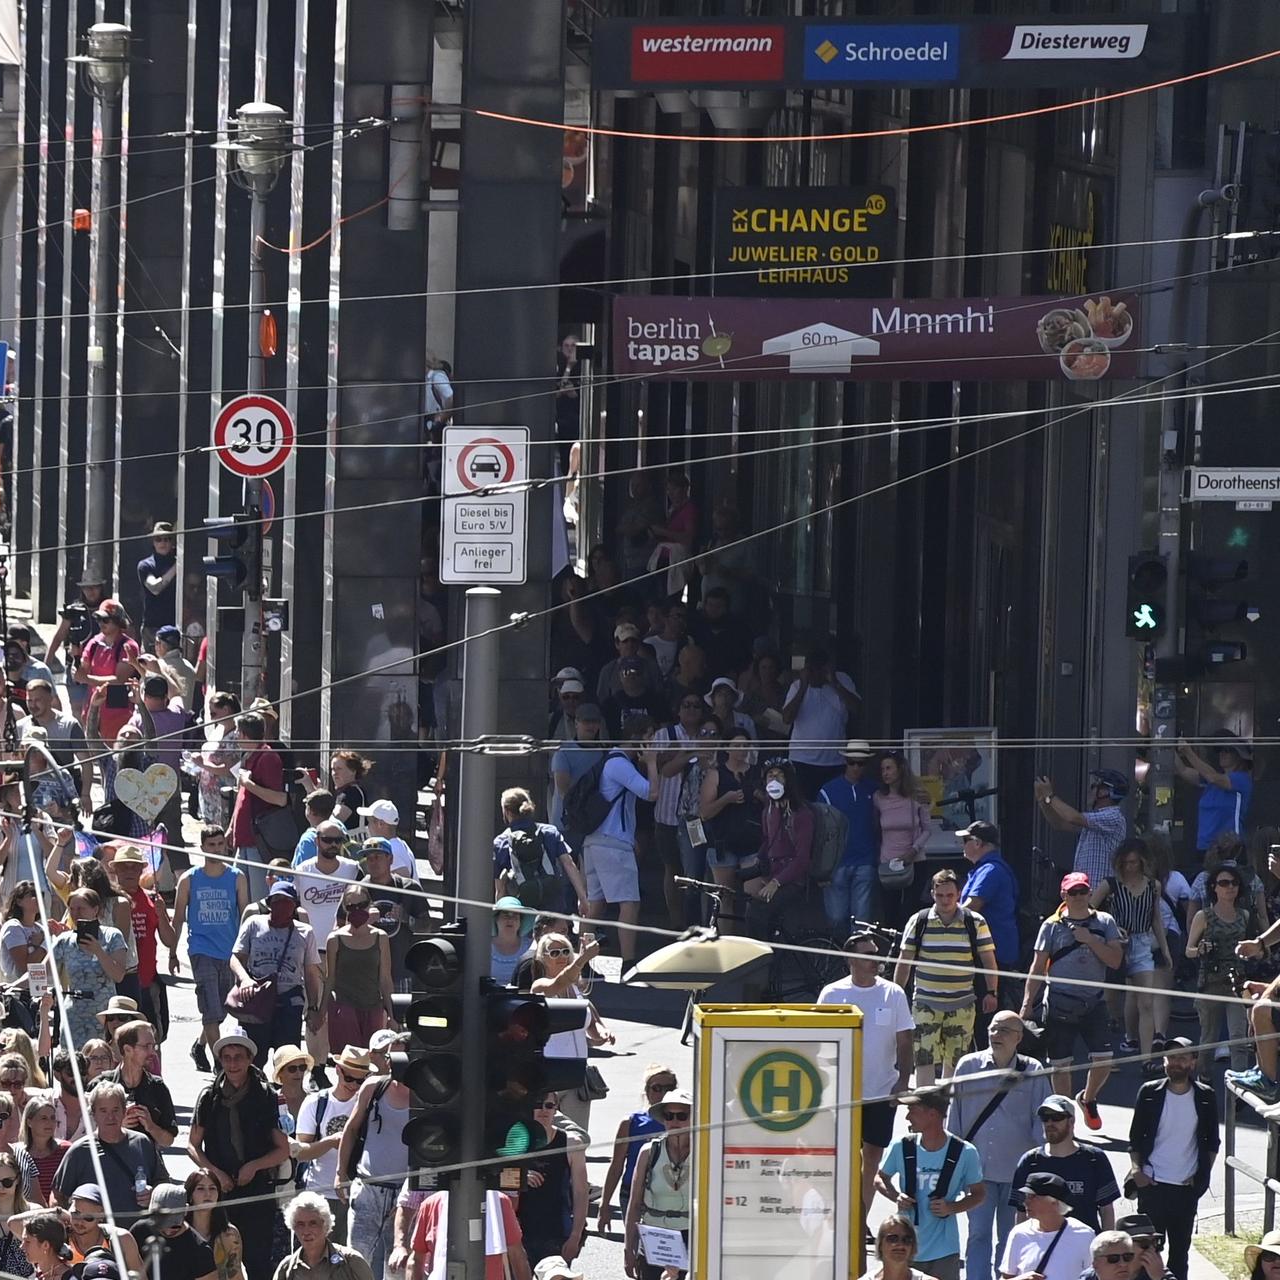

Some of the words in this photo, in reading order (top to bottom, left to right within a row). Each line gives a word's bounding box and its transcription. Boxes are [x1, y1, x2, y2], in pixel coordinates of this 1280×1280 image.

[641, 35, 772, 54] westermann
[1020, 31, 1131, 53] Diesterweg
[844, 41, 948, 62] Schroedel
[866, 199, 885, 211] AG
[727, 246, 819, 263] JUWELIER
[829, 246, 880, 263] GOLD
[757, 268, 849, 285] LEIHHAUS
[627, 316, 701, 340] berlin
[871, 306, 996, 336] Mmmh!
[626, 341, 700, 365] tapas
[231, 418, 276, 455] 30
[460, 506, 491, 518] Diesel
[494, 506, 509, 518] bis
[461, 520, 486, 531] Euro
[489, 520, 507, 532] 5/V
[460, 546, 507, 561] Anlieger
[474, 558, 493, 571] frei
[762, 1069, 802, 1113] H
[734, 1160, 751, 1170] M1
[760, 1168, 773, 1178] Am
[734, 1196, 749, 1206] 12
[760, 1205, 773, 1214] Am
